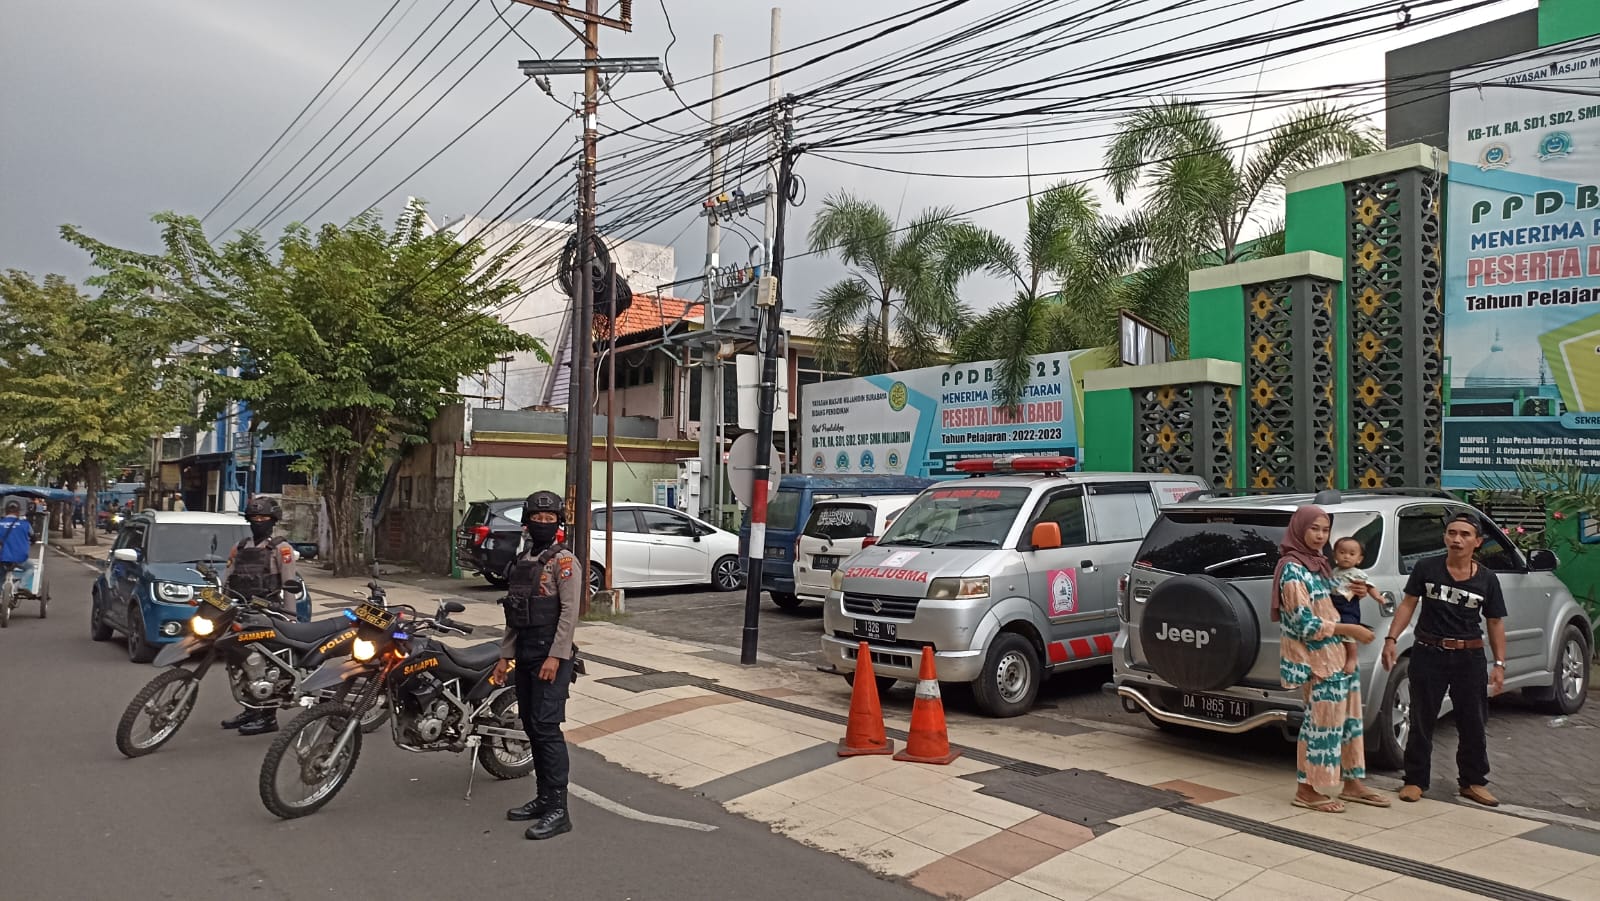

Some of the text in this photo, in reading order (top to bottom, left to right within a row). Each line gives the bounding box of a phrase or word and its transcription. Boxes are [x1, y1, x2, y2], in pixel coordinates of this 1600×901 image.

[1471, 221, 1585, 250] MENERIMA
[1467, 247, 1581, 288] PESERTA
[1467, 293, 1523, 311] Tahun
[942, 389, 989, 404] MENERIMA
[942, 406, 989, 428] PESERTA
[1027, 400, 1063, 423] BARU
[942, 433, 965, 444] Tahun
[966, 432, 1007, 443] Pelajaran
[1012, 428, 1062, 441] 2022-2023
[1424, 582, 1484, 609] LIFE
[237, 630, 276, 642] SAMAPTA
[864, 621, 880, 633] 1326
[1156, 623, 1210, 648] Jeep
[1201, 696, 1225, 713] 1865
